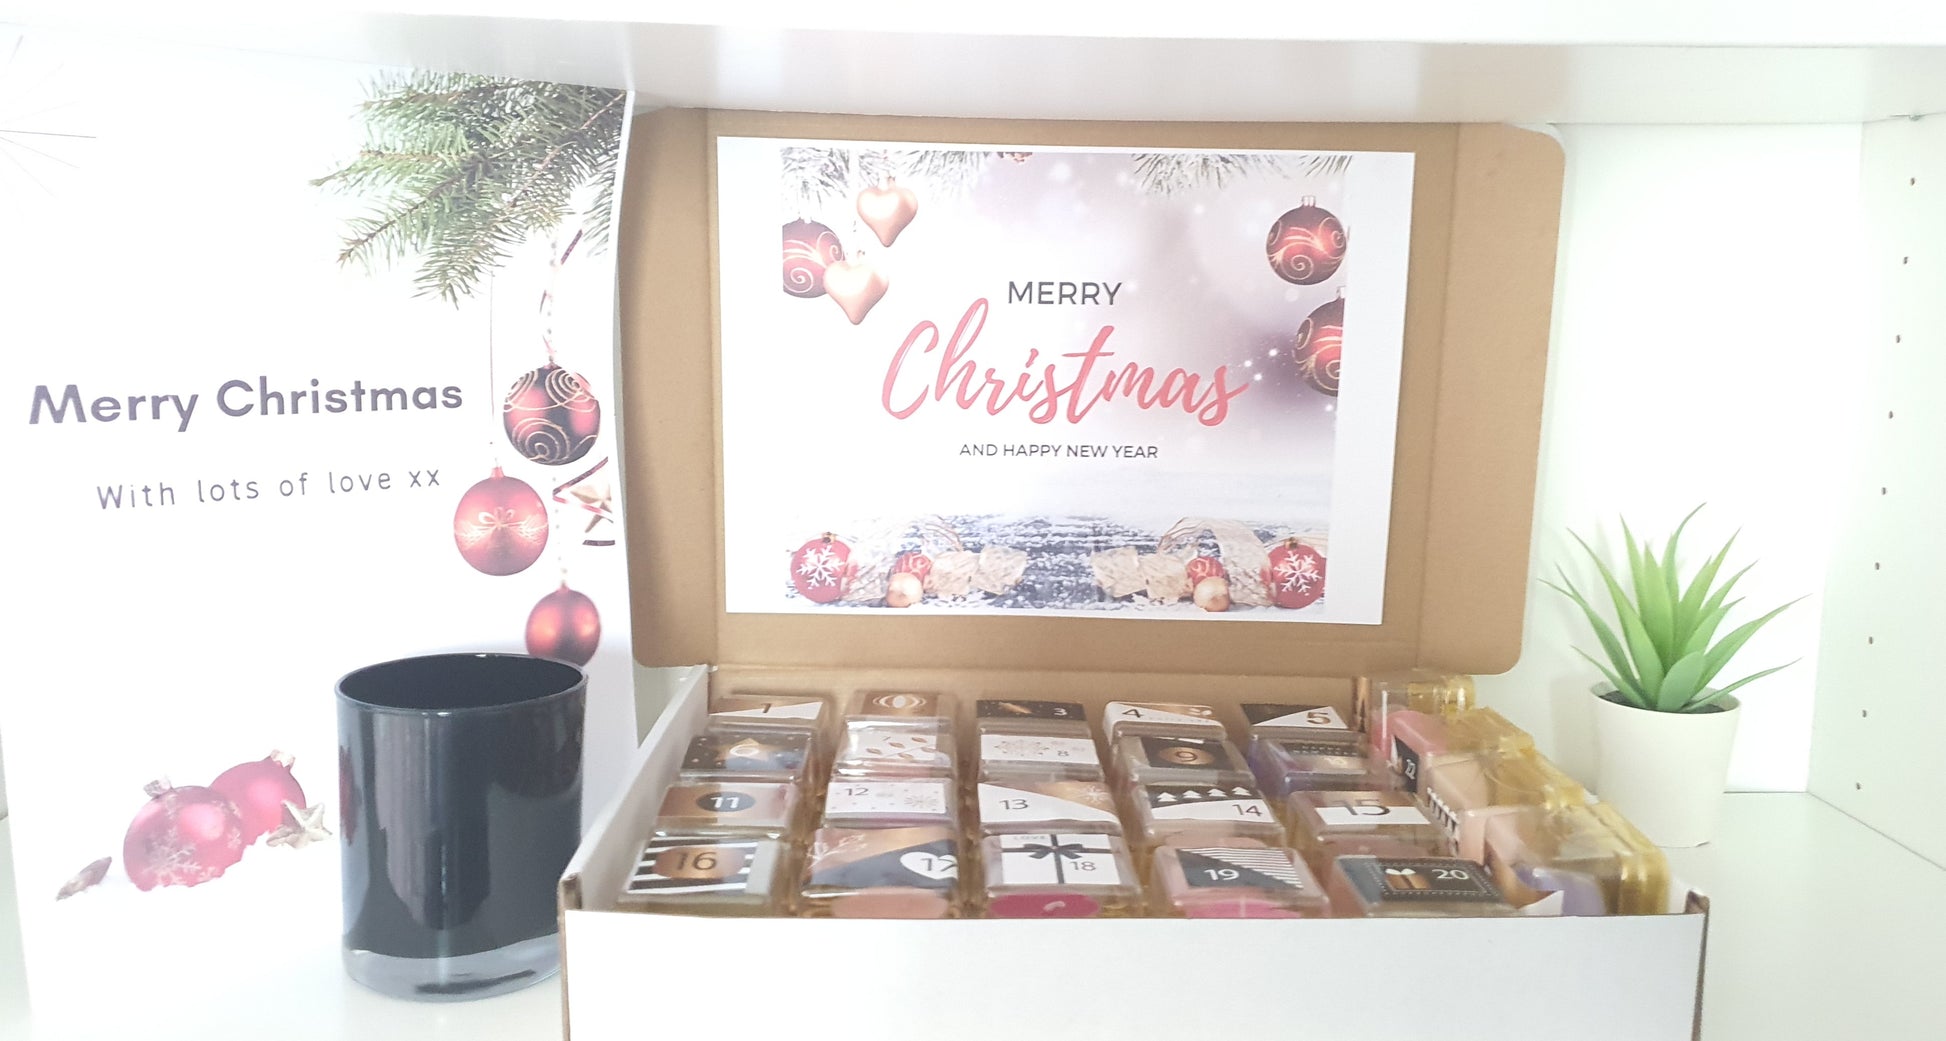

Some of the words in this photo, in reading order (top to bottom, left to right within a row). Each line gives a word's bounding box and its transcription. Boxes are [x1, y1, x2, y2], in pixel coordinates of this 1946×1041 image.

[1009, 281, 1123, 305] MERRY
[881, 297, 1250, 427] Christmas
[29, 384, 199, 432] Merry
[216, 376, 464, 417] Christmas
[959, 444, 998, 456] AND
[1003, 444, 1062, 457] HAPPY
[1066, 445, 1108, 458] NEW
[1112, 445, 1158, 459] YEAR
[96, 482, 175, 510] With
[197, 479, 260, 503] lots
[279, 472, 309, 497] of
[328, 471, 391, 494] love
[408, 469, 441, 488] xx
[1053, 707, 1068, 716] 3
[1122, 708, 1143, 718] 4
[1306, 711, 1332, 725] 5
[1174, 750, 1198, 762] 9
[844, 786, 870, 797] 12
[710, 797, 741, 809] 11
[1000, 799, 1029, 811] 13
[1331, 799, 1391, 817] 15
[1232, 803, 1264, 817] 14
[677, 851, 718, 870] 16
[1069, 860, 1097, 872] 18
[1203, 868, 1240, 881] 19
[1431, 868, 1470, 880] 20
